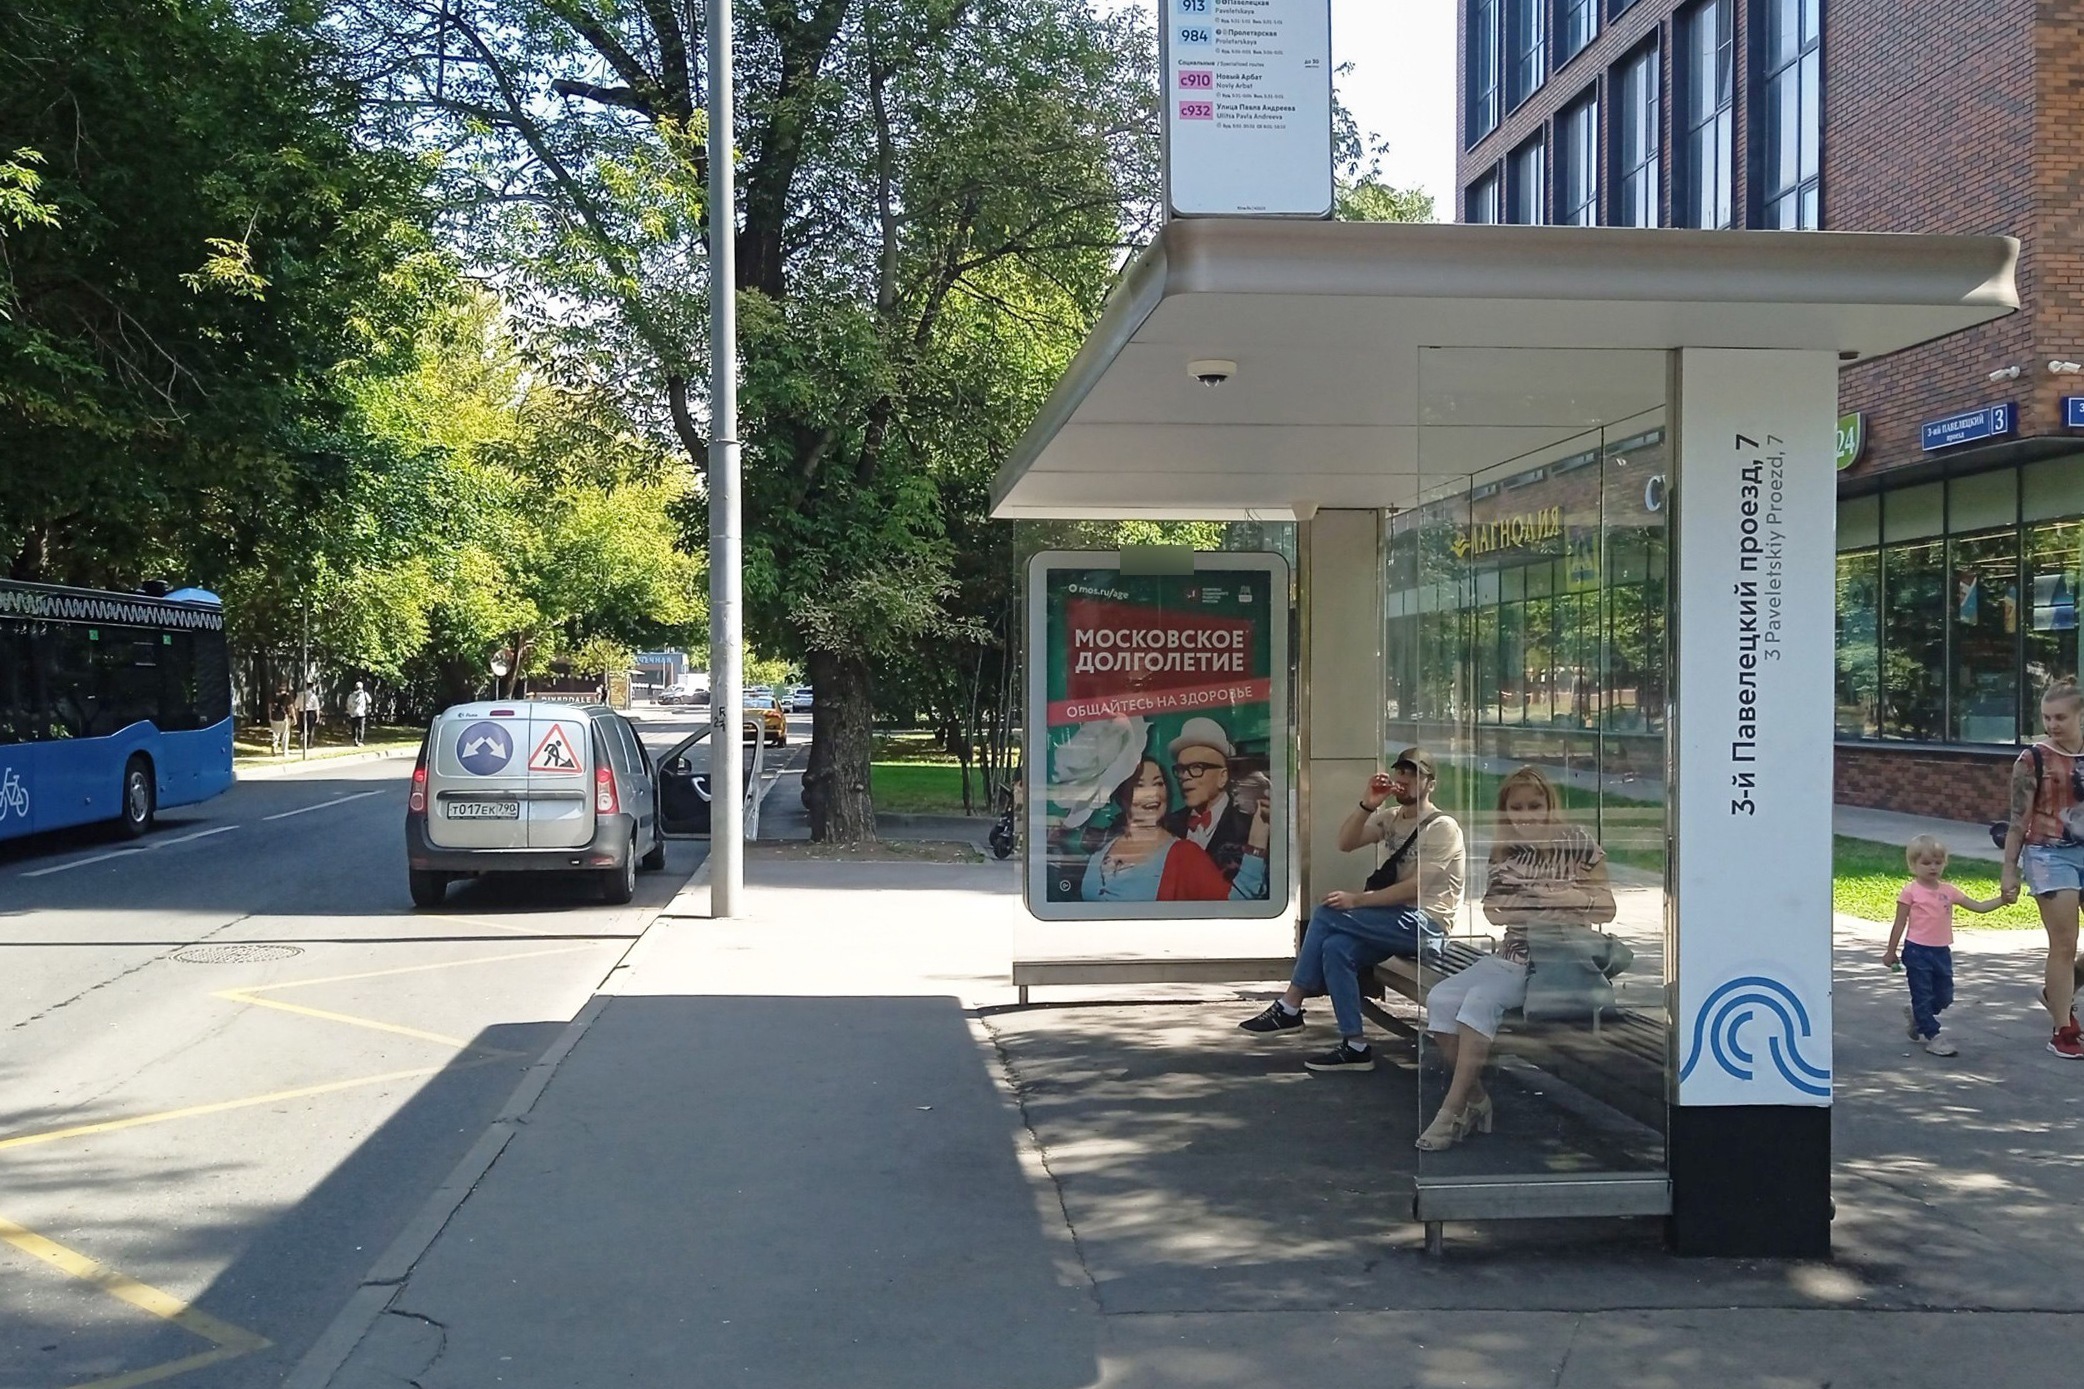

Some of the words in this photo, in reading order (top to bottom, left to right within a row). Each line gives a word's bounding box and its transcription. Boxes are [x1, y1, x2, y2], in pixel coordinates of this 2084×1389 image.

[1182, 0, 1206, 12] 913
[1181, 29, 1208, 42] 984
[1216, 103, 1238, 111] Улица
[1942, 413, 1984, 431] ПАВЕЛЕЦКИЙ
[1995, 409, 2004, 430] 3
[1736, 433, 1760, 450] 7
[1767, 434, 1784, 446] 7
[1765, 451, 1787, 524] Proezd,
[1738, 457, 1764, 571] проезд,
[1079, 586, 1129, 600] mos.ru/age
[1764, 530, 1787, 643] Paveletskiy
[1075, 629, 1244, 649] МОСКОВСКОЕ
[1075, 652, 1244, 673] ДОЛГОЛЕТИЕ
[1764, 649, 1781, 661] 3
[1732, 581, 1761, 762] Павелецкий
[1067, 698, 1154, 718] ОБЩАЙТЕСЬ
[1157, 697, 1177, 709] НА
[1180, 686, 1252, 705] ЗДОРОВЬЕ
[1731, 773, 1756, 816] 3-й
